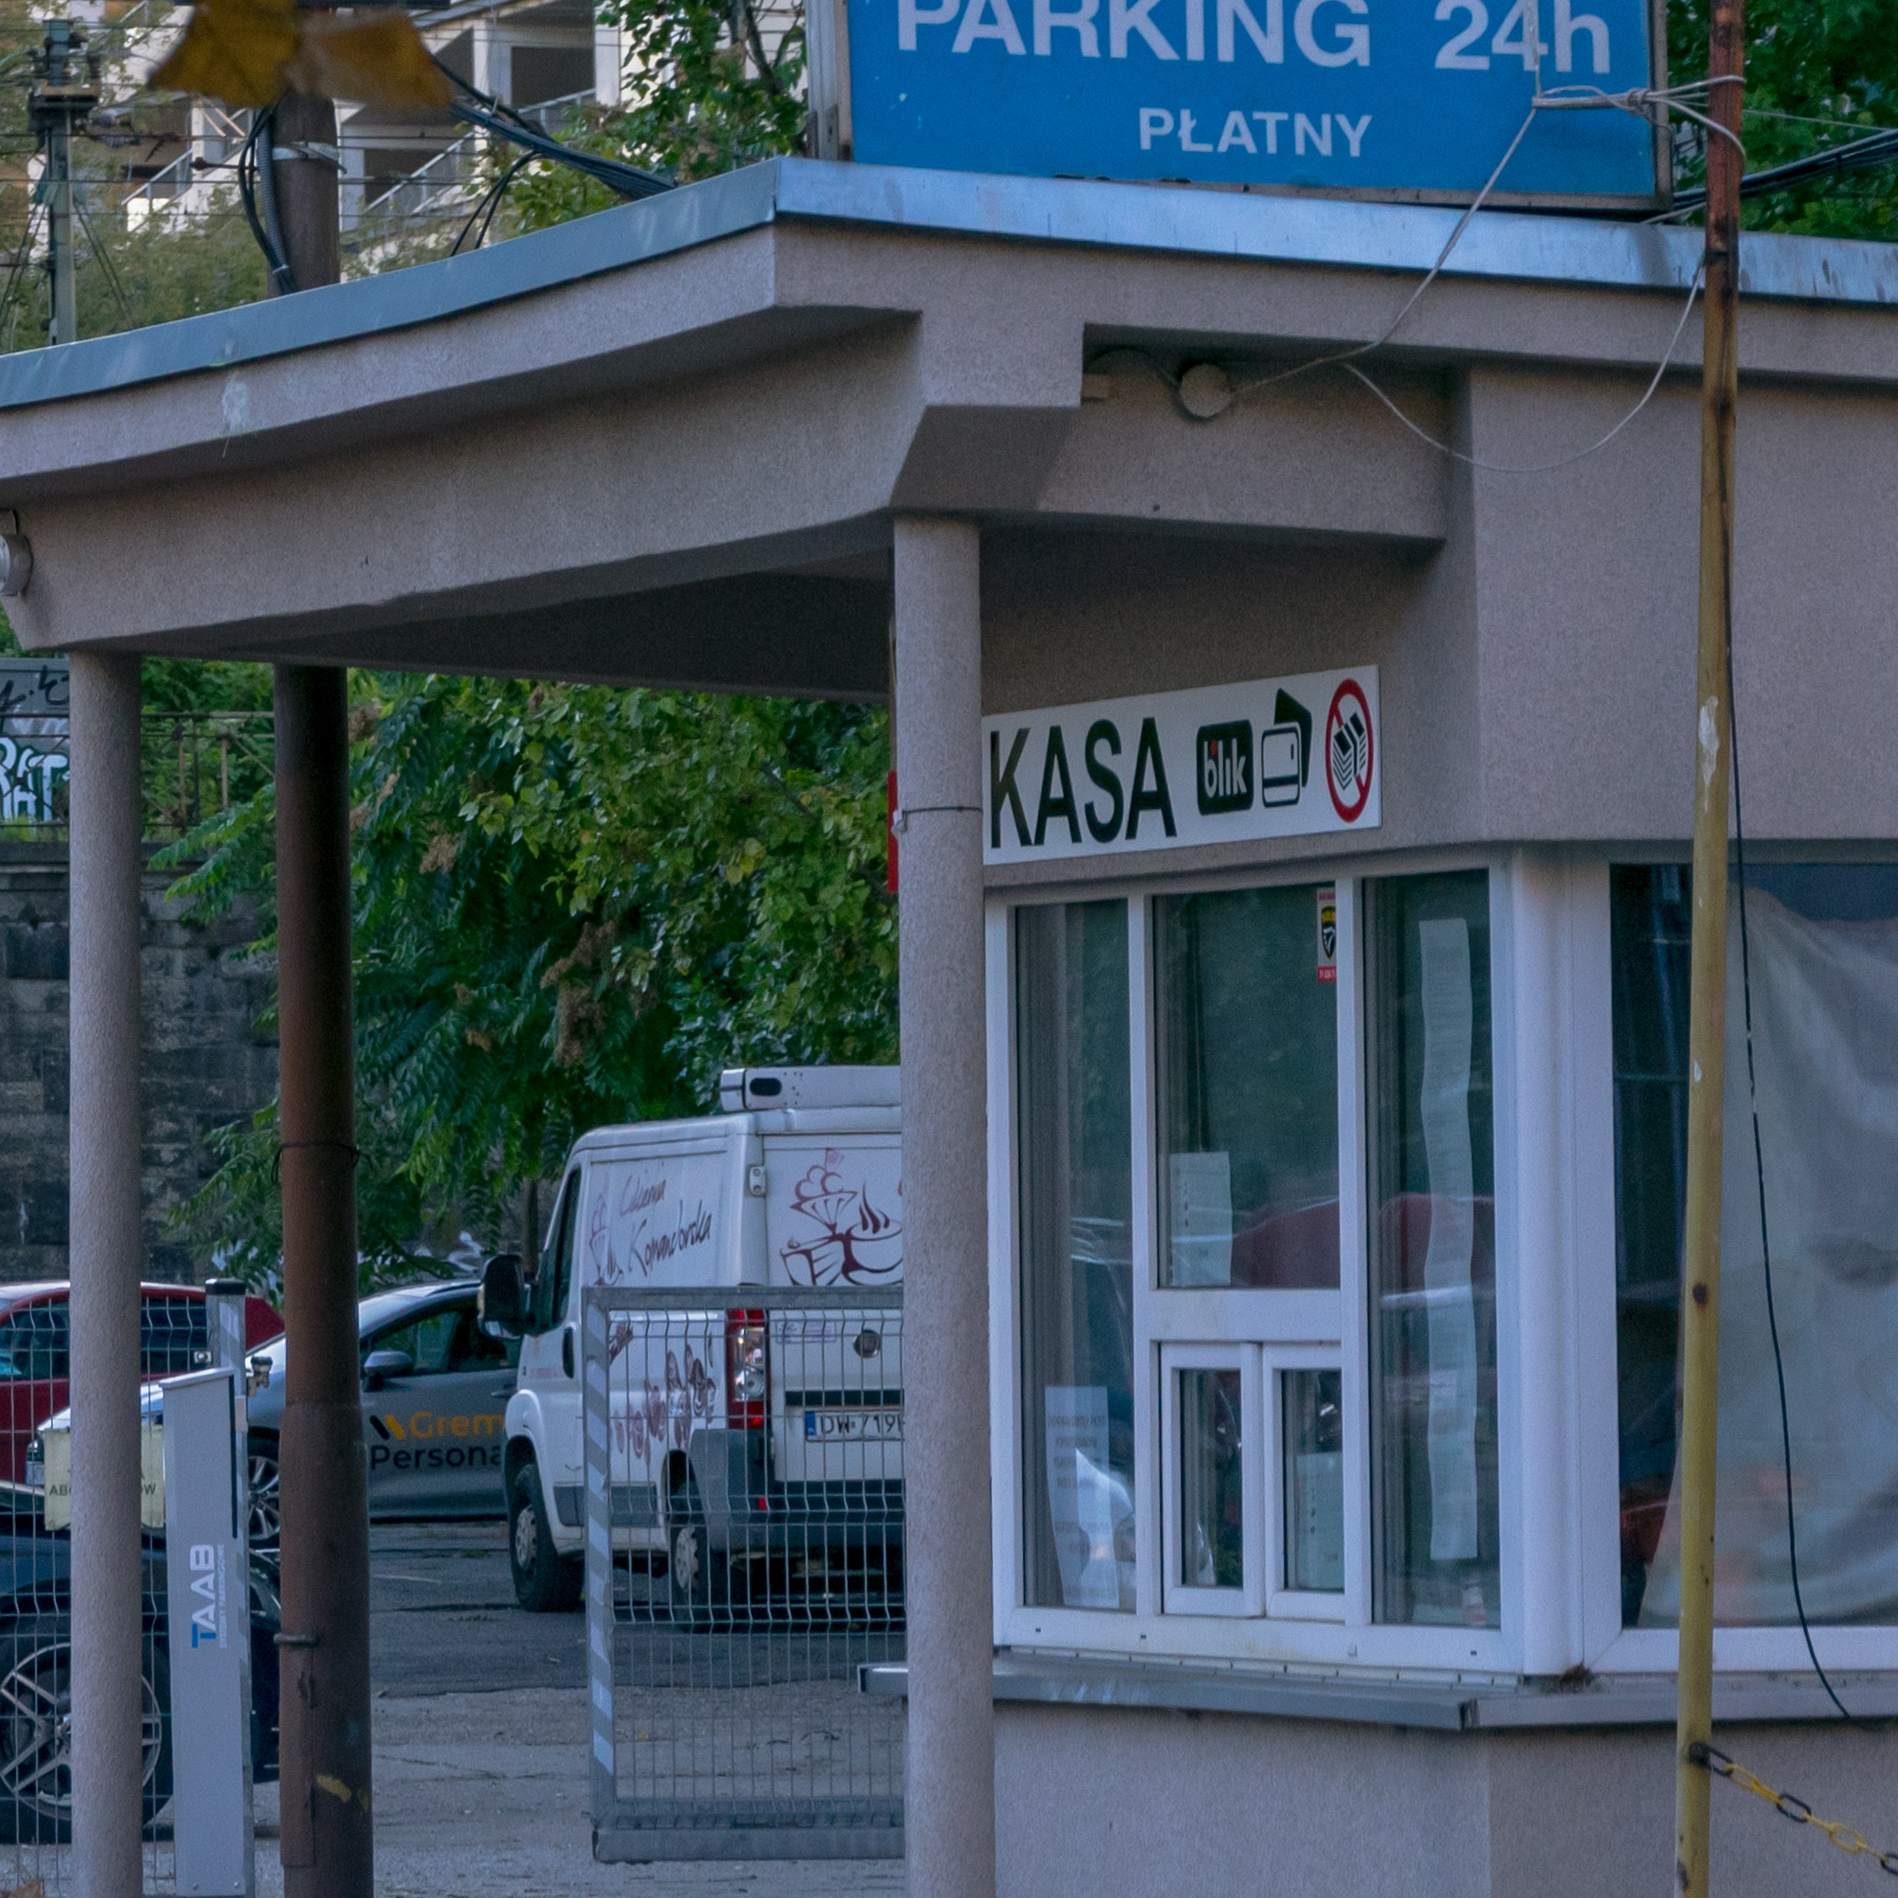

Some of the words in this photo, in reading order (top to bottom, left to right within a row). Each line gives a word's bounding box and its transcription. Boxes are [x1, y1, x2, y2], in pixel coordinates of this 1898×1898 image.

[1139, 106, 1373, 159] PŁATNY
[990, 717, 1178, 849] KASA
[1204, 737, 1248, 799] blik
[189, 1544, 216, 1649] TAAB
